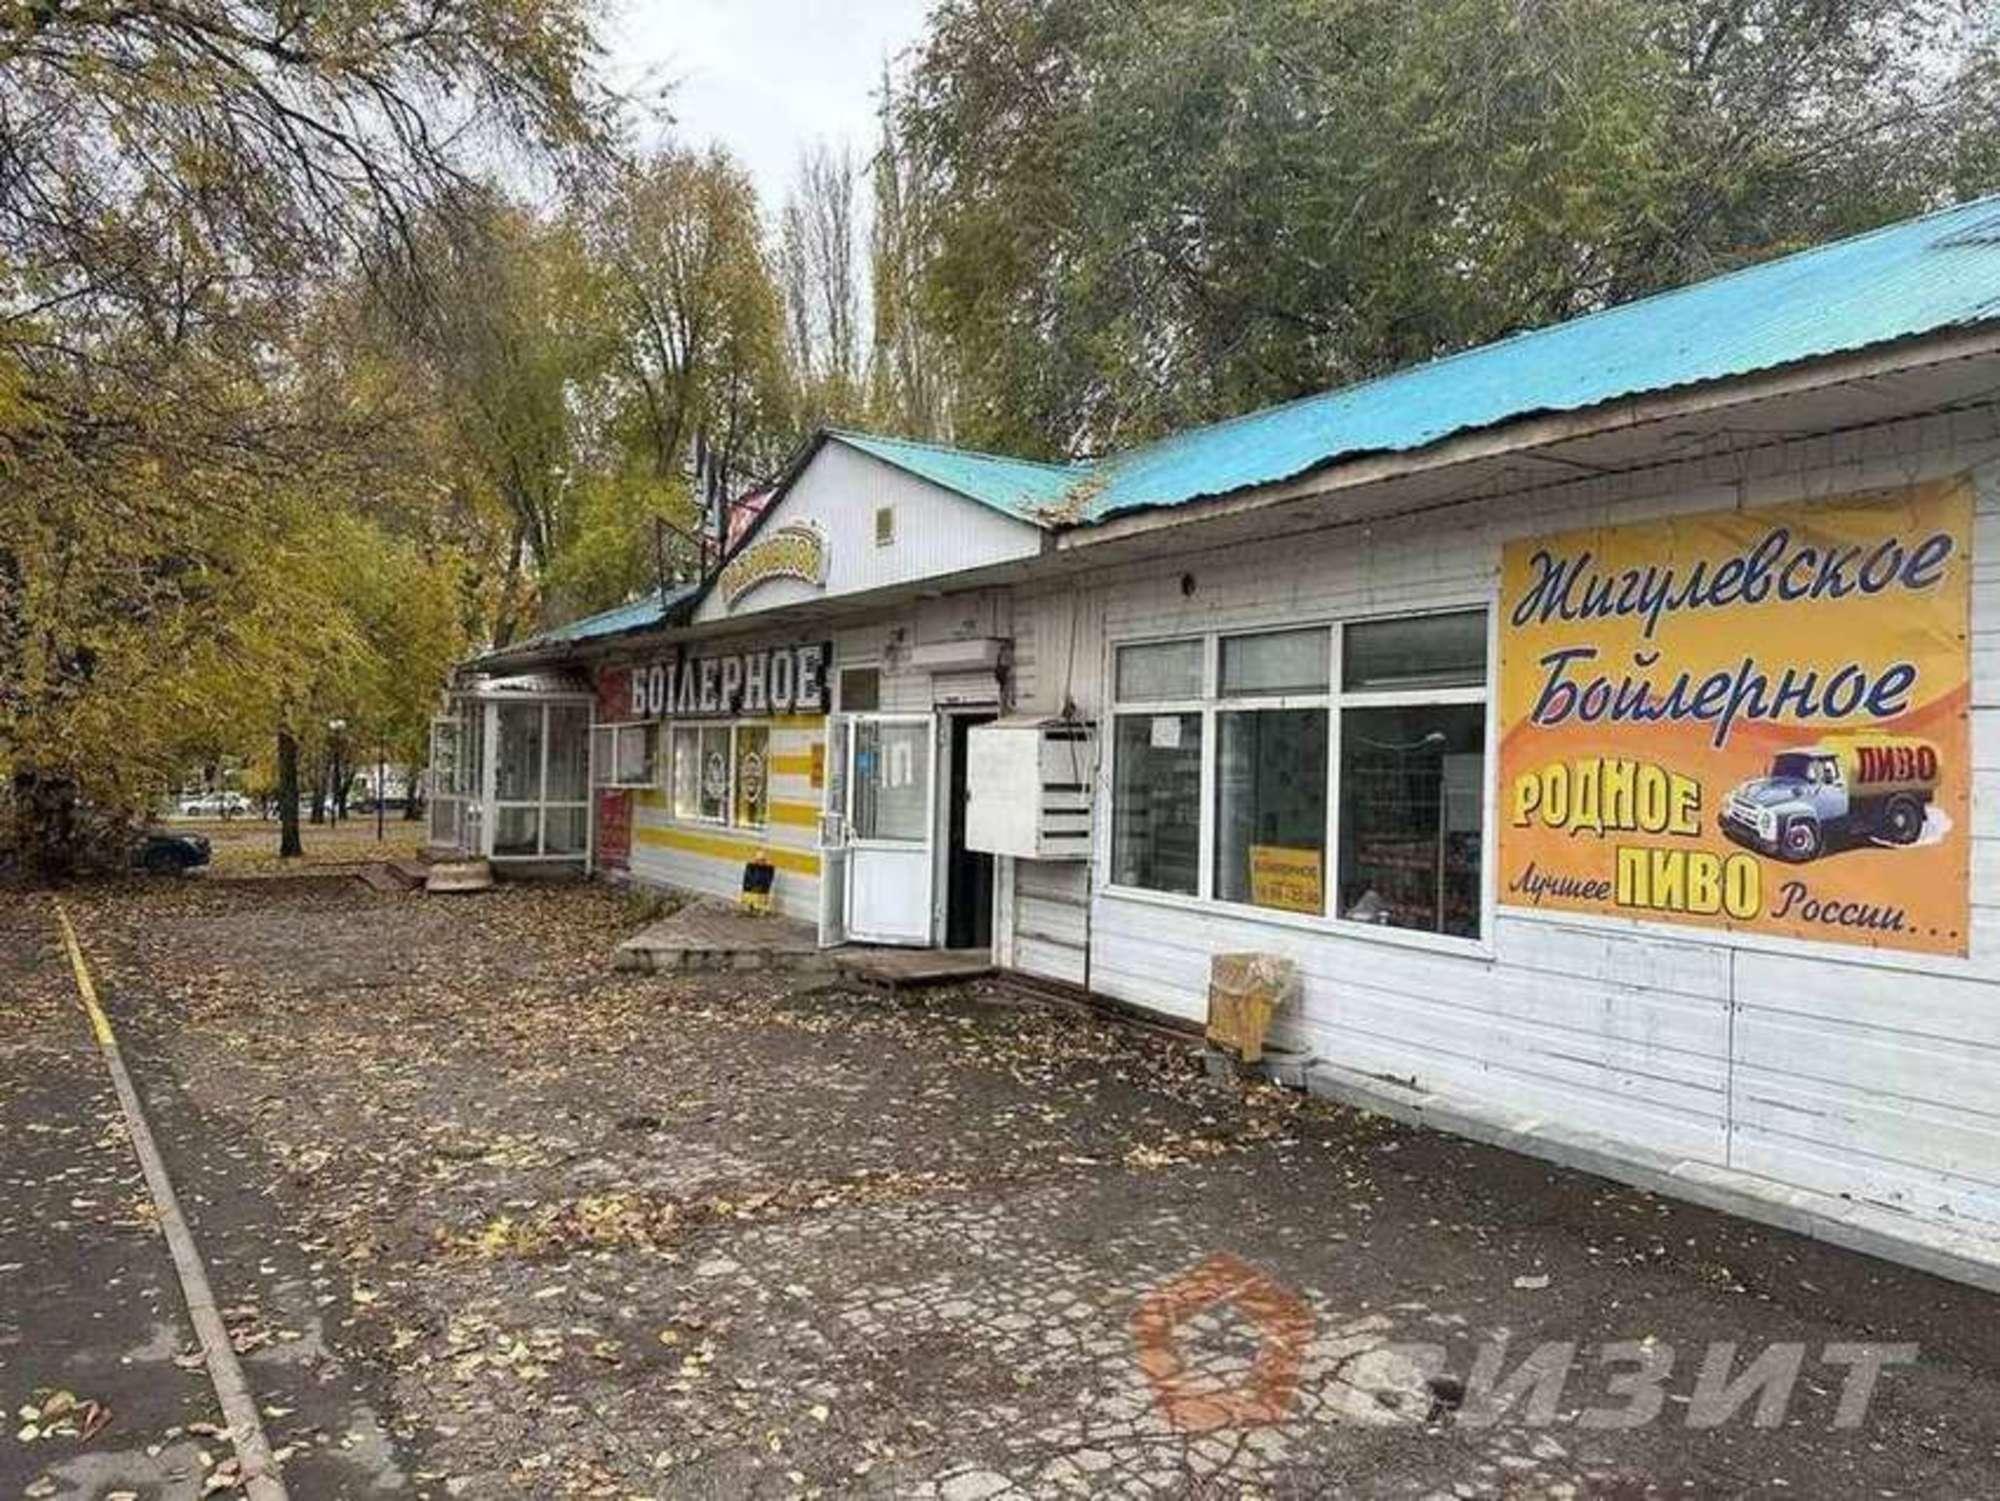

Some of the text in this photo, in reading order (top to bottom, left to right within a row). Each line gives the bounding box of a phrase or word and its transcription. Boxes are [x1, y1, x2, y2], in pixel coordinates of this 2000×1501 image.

[1511, 527, 1955, 638] Жигулевское
[1530, 648, 1918, 748] Бойлерное
[1513, 756, 1702, 838] РОДНОЕ
[1855, 746, 1938, 783] ПИВО
[1509, 861, 1611, 904] Лучшее
[1616, 845, 1762, 920] ПИВО
